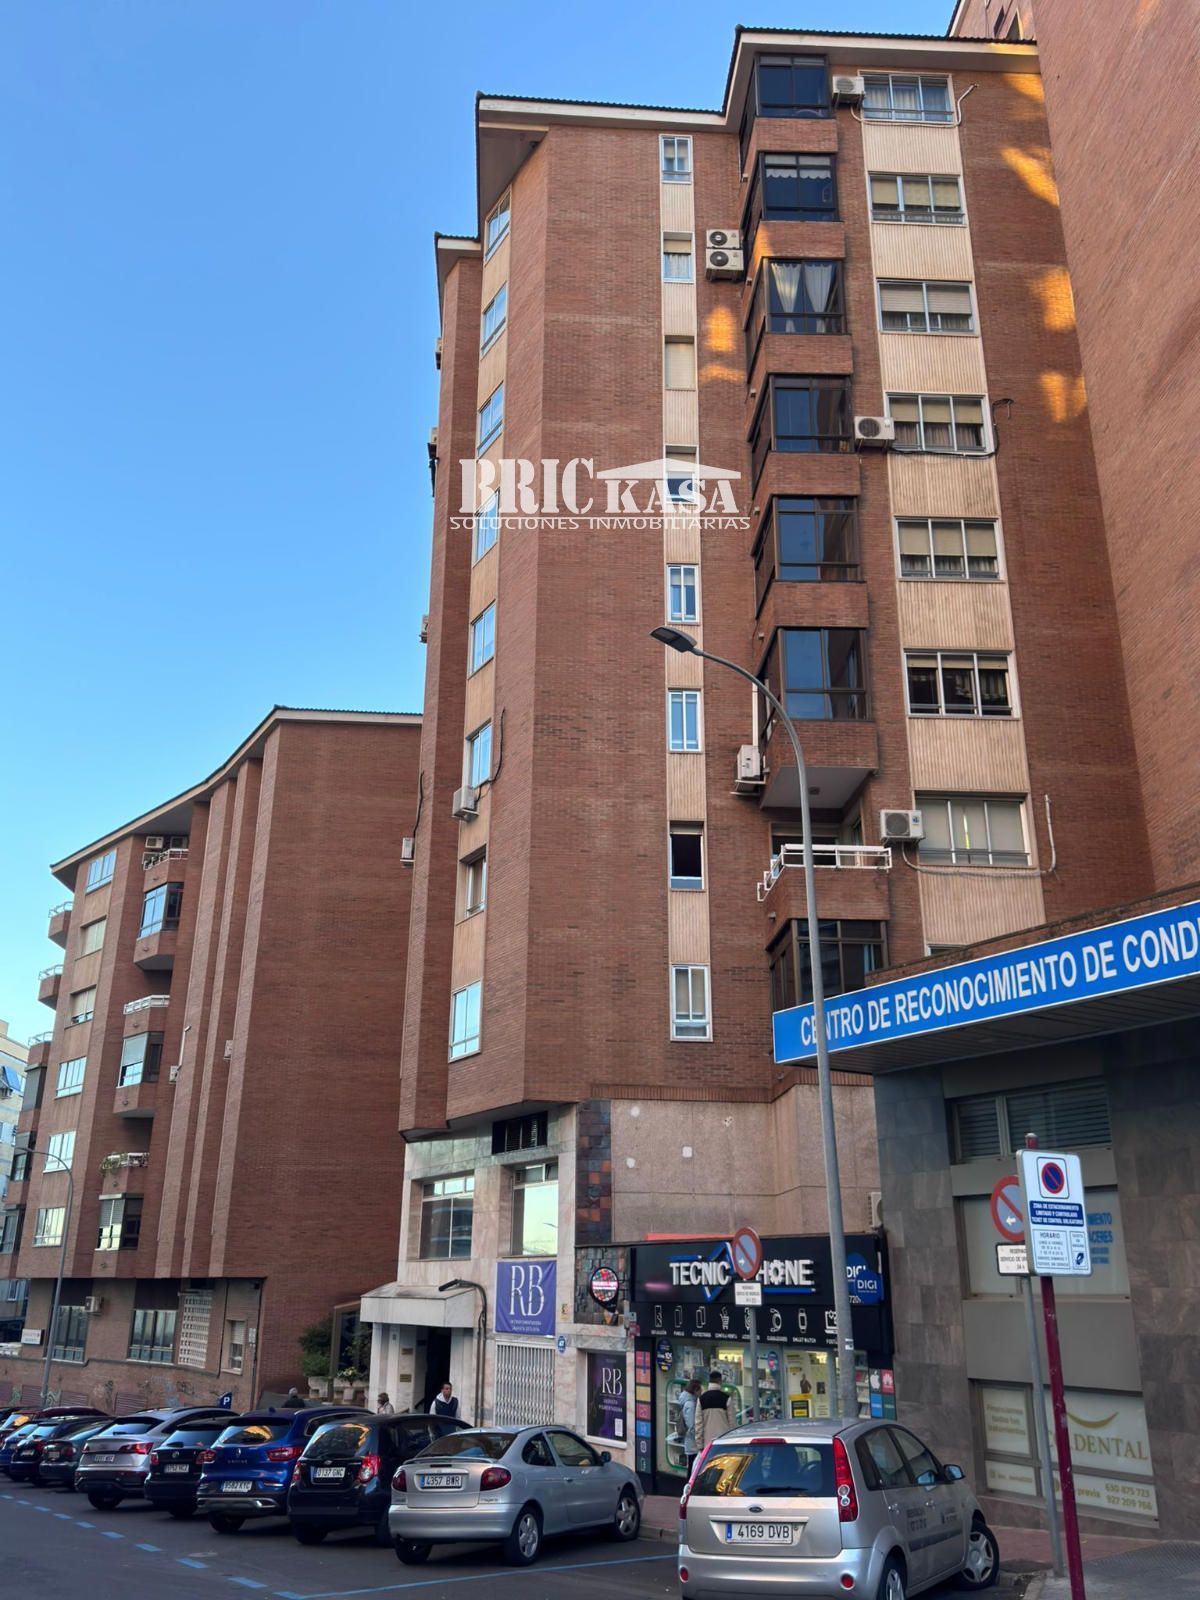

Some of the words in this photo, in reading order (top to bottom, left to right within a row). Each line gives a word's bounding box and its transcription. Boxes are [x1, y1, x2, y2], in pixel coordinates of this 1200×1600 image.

[868, 997, 892, 1031] DE
[895, 951, 1077, 1025] RECONOCIMIENTO
[1082, 940, 1117, 982] DE
[1122, 917, 1200, 973] COND
[754, 1259, 815, 1286] HONE
[857, 1279, 878, 1290] DIGI
[509, 1265, 545, 1316] RB
[602, 1367, 623, 1395] RB
[223, 1396, 231, 1406] P
[1073, 1433, 1148, 1460] DENTAL
[737, 1525, 764, 1538] 4169
[768, 1525, 790, 1539] DVB
